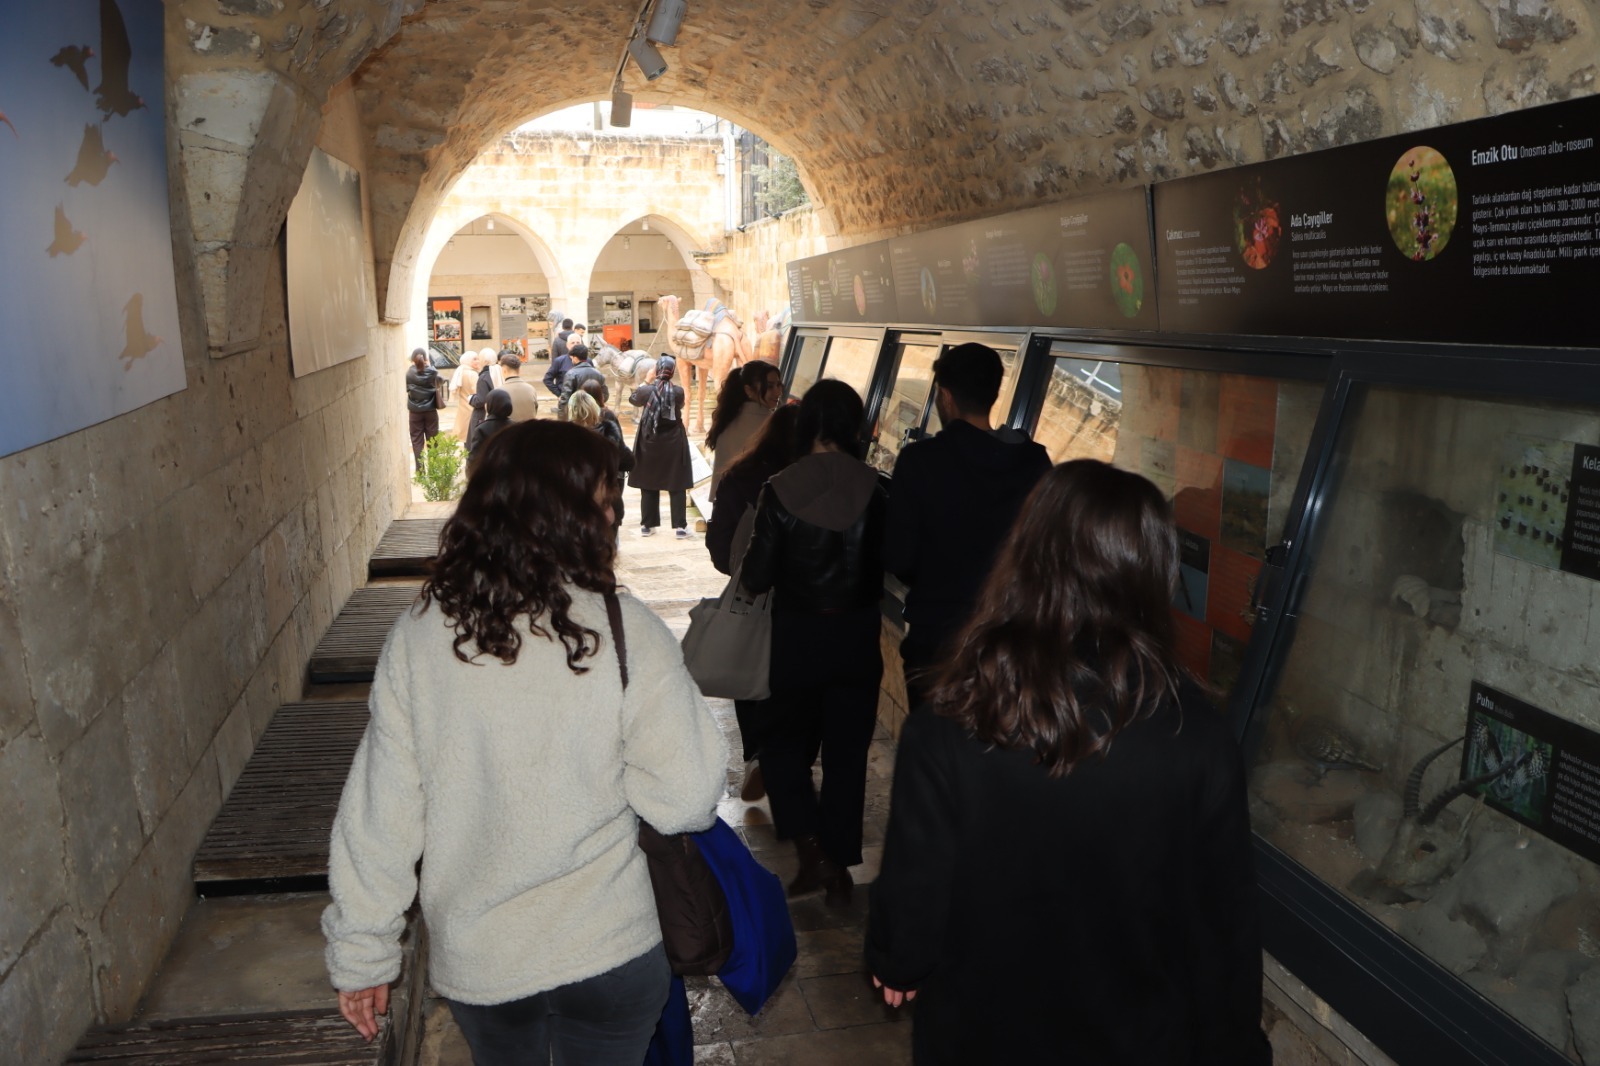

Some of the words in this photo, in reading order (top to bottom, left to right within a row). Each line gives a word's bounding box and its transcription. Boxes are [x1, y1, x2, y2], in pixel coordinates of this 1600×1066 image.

[1472, 147, 1499, 166] Emzik
[1501, 144, 1518, 161] Otu
[1520, 146, 1547, 158] Onosma
[1548, 138, 1593, 154] albo-roseum
[1533, 186, 1562, 200] steplerine
[1563, 184, 1580, 195] kadar
[1494, 207, 1504, 219] Çok
[1520, 205, 1532, 214] olan
[1534, 204, 1541, 213] bu
[1542, 201, 1556, 212] bitki
[1290, 214, 1302, 227] Ada
[1528, 218, 1561, 231] çiçeklenme
[1562, 214, 1593, 227] zamanıdır.
[1498, 238, 1504, 246] ve
[1506, 250, 1522, 262] kuzey
[1559, 246, 1573, 258] Milli
[1573, 246, 1588, 259] park
[1502, 265, 1508, 274] de
[1509, 263, 1551, 274] bulunmaktadır.
[1583, 456, 1600, 471] Kela
[1476, 692, 1494, 710] Puhu
